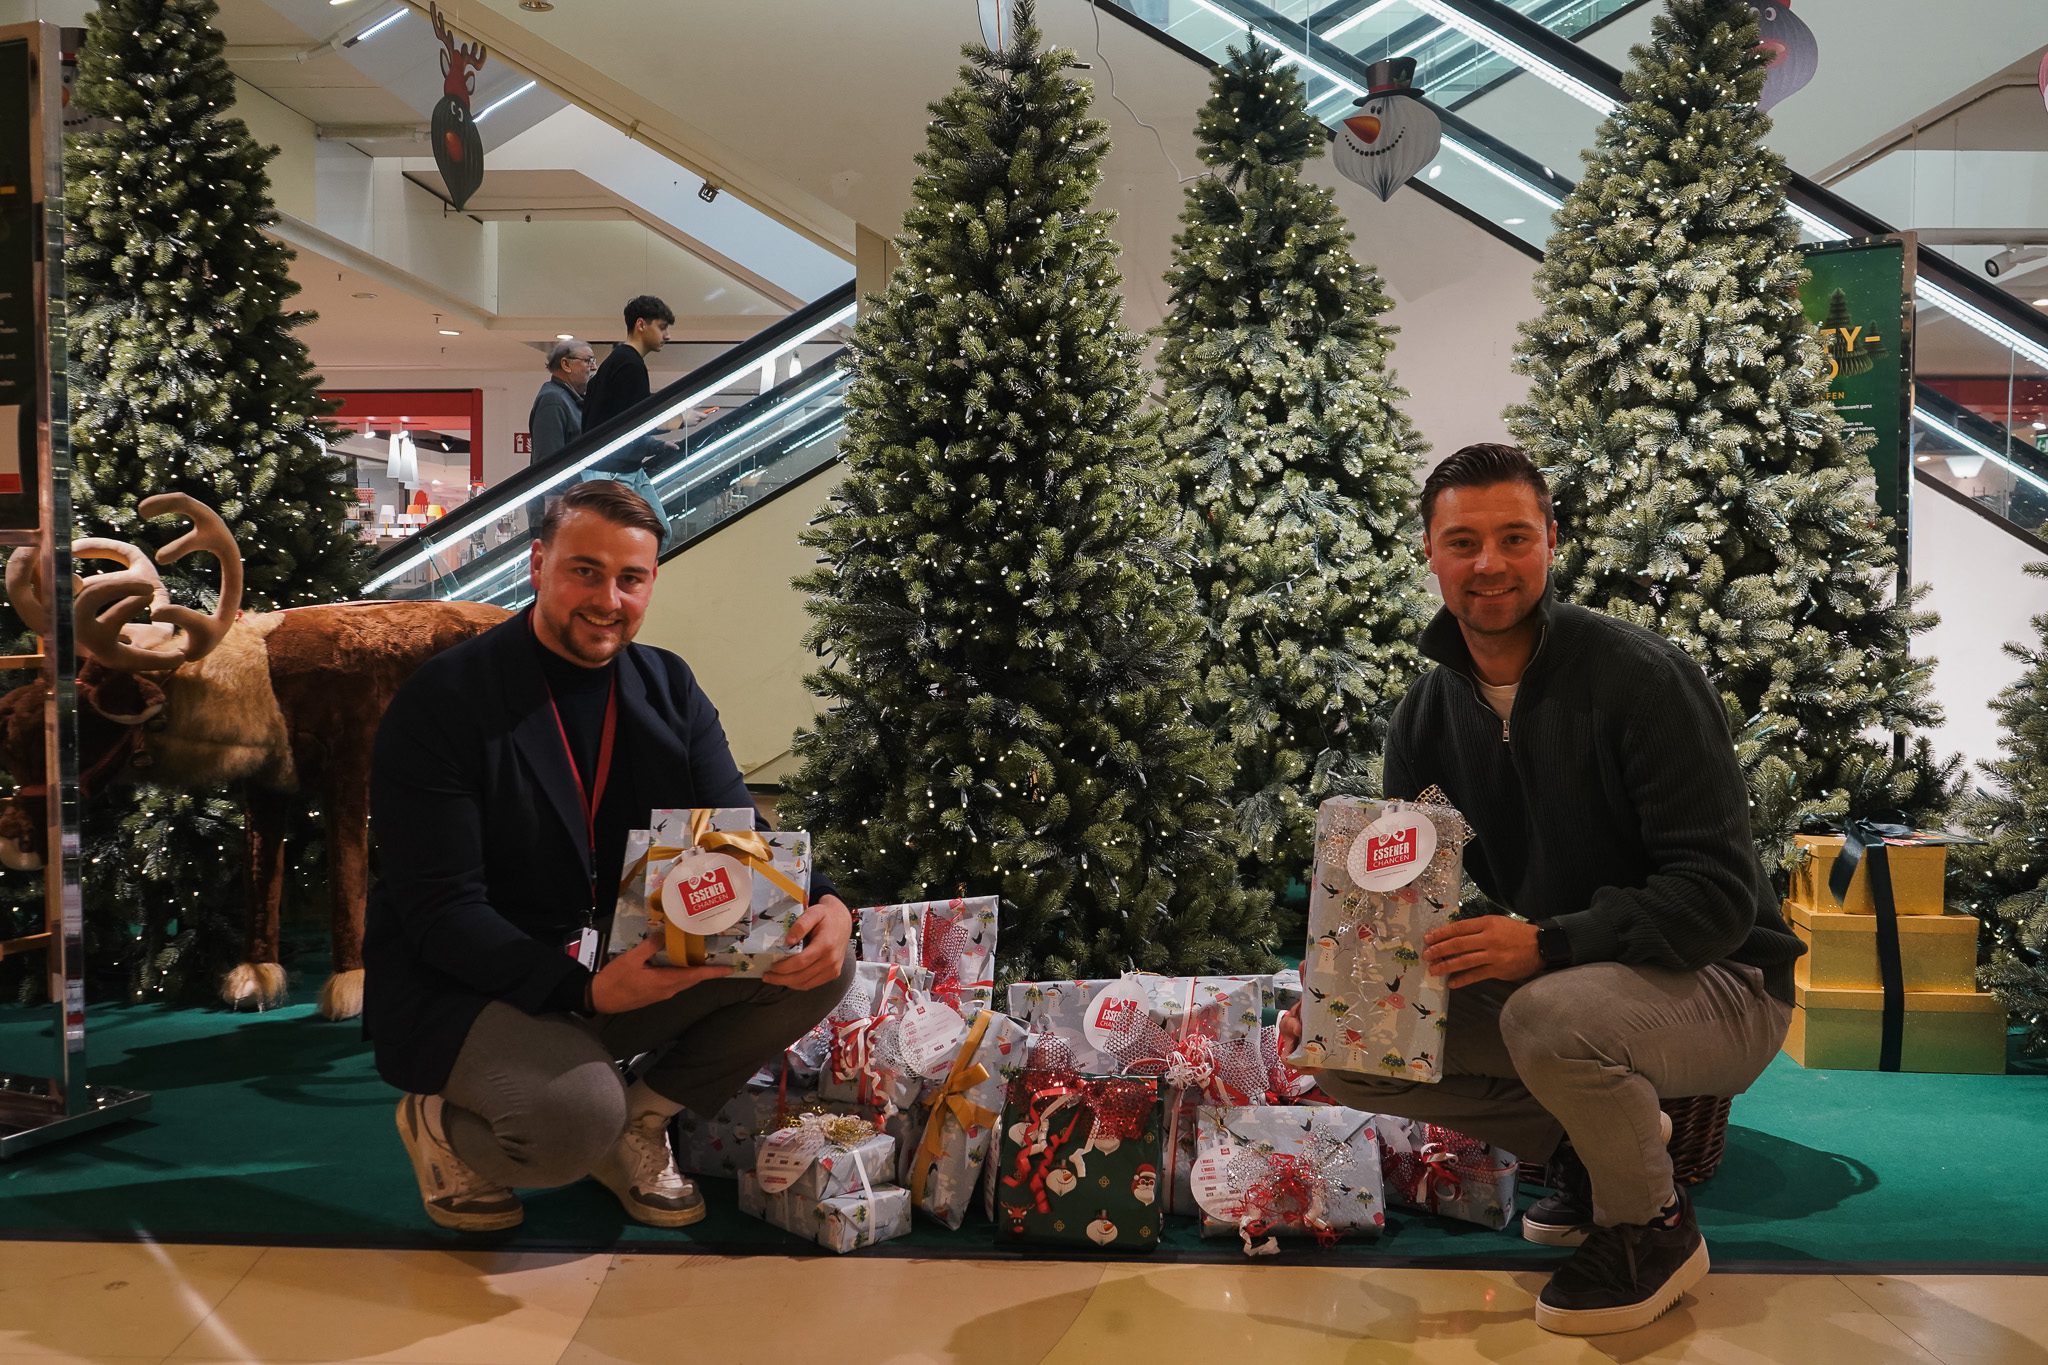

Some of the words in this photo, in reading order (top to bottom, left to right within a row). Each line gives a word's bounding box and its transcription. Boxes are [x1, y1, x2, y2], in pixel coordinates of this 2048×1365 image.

[1373, 842, 1410, 861] ESSENER
[1373, 855, 1410, 868] CHANCEN
[688, 881, 726, 905] ESSENER
[693, 893, 729, 911] CHANCEN
